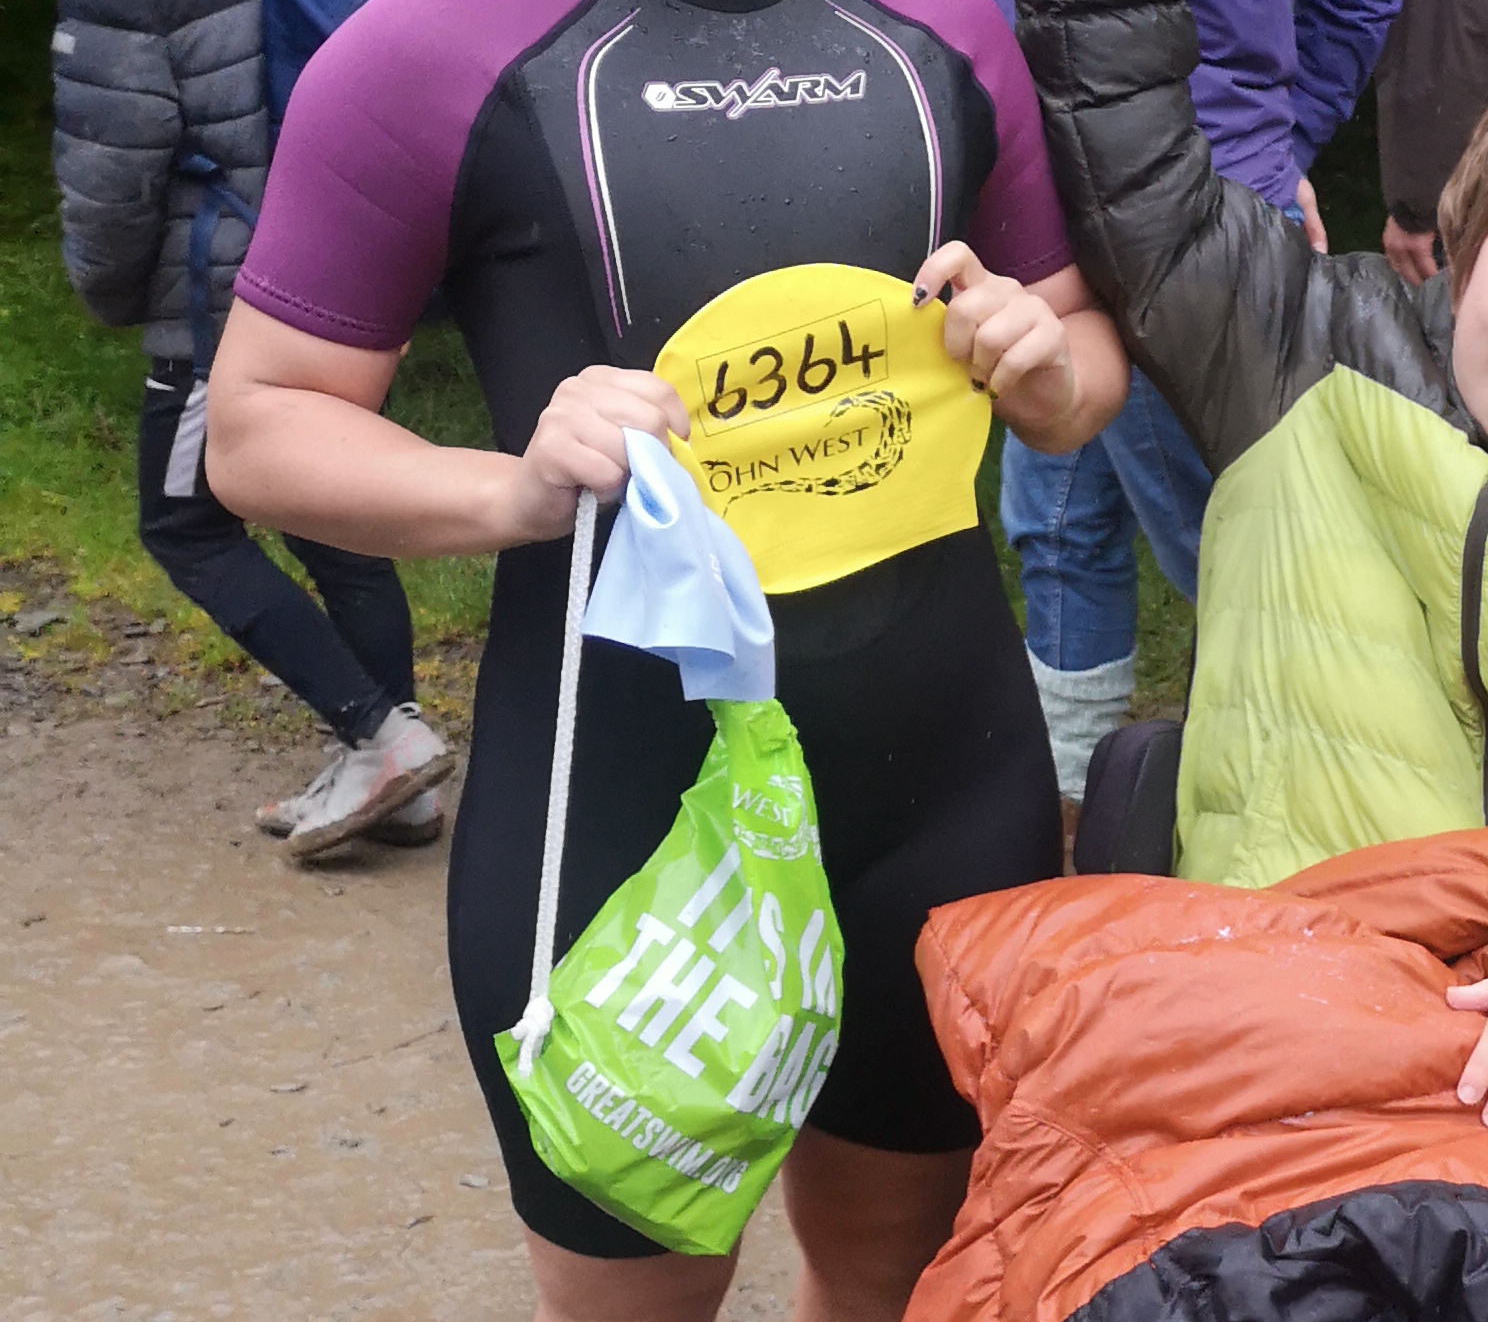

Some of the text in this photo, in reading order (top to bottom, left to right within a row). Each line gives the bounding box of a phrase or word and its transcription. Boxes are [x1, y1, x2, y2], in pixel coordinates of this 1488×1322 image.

[673, 67, 866, 119] SWARM
[707, 319, 884, 421] 6364
[709, 426, 870, 493] OHN WEST
[732, 782, 792, 827] WEST
[584, 912, 838, 1129] THE BAG
